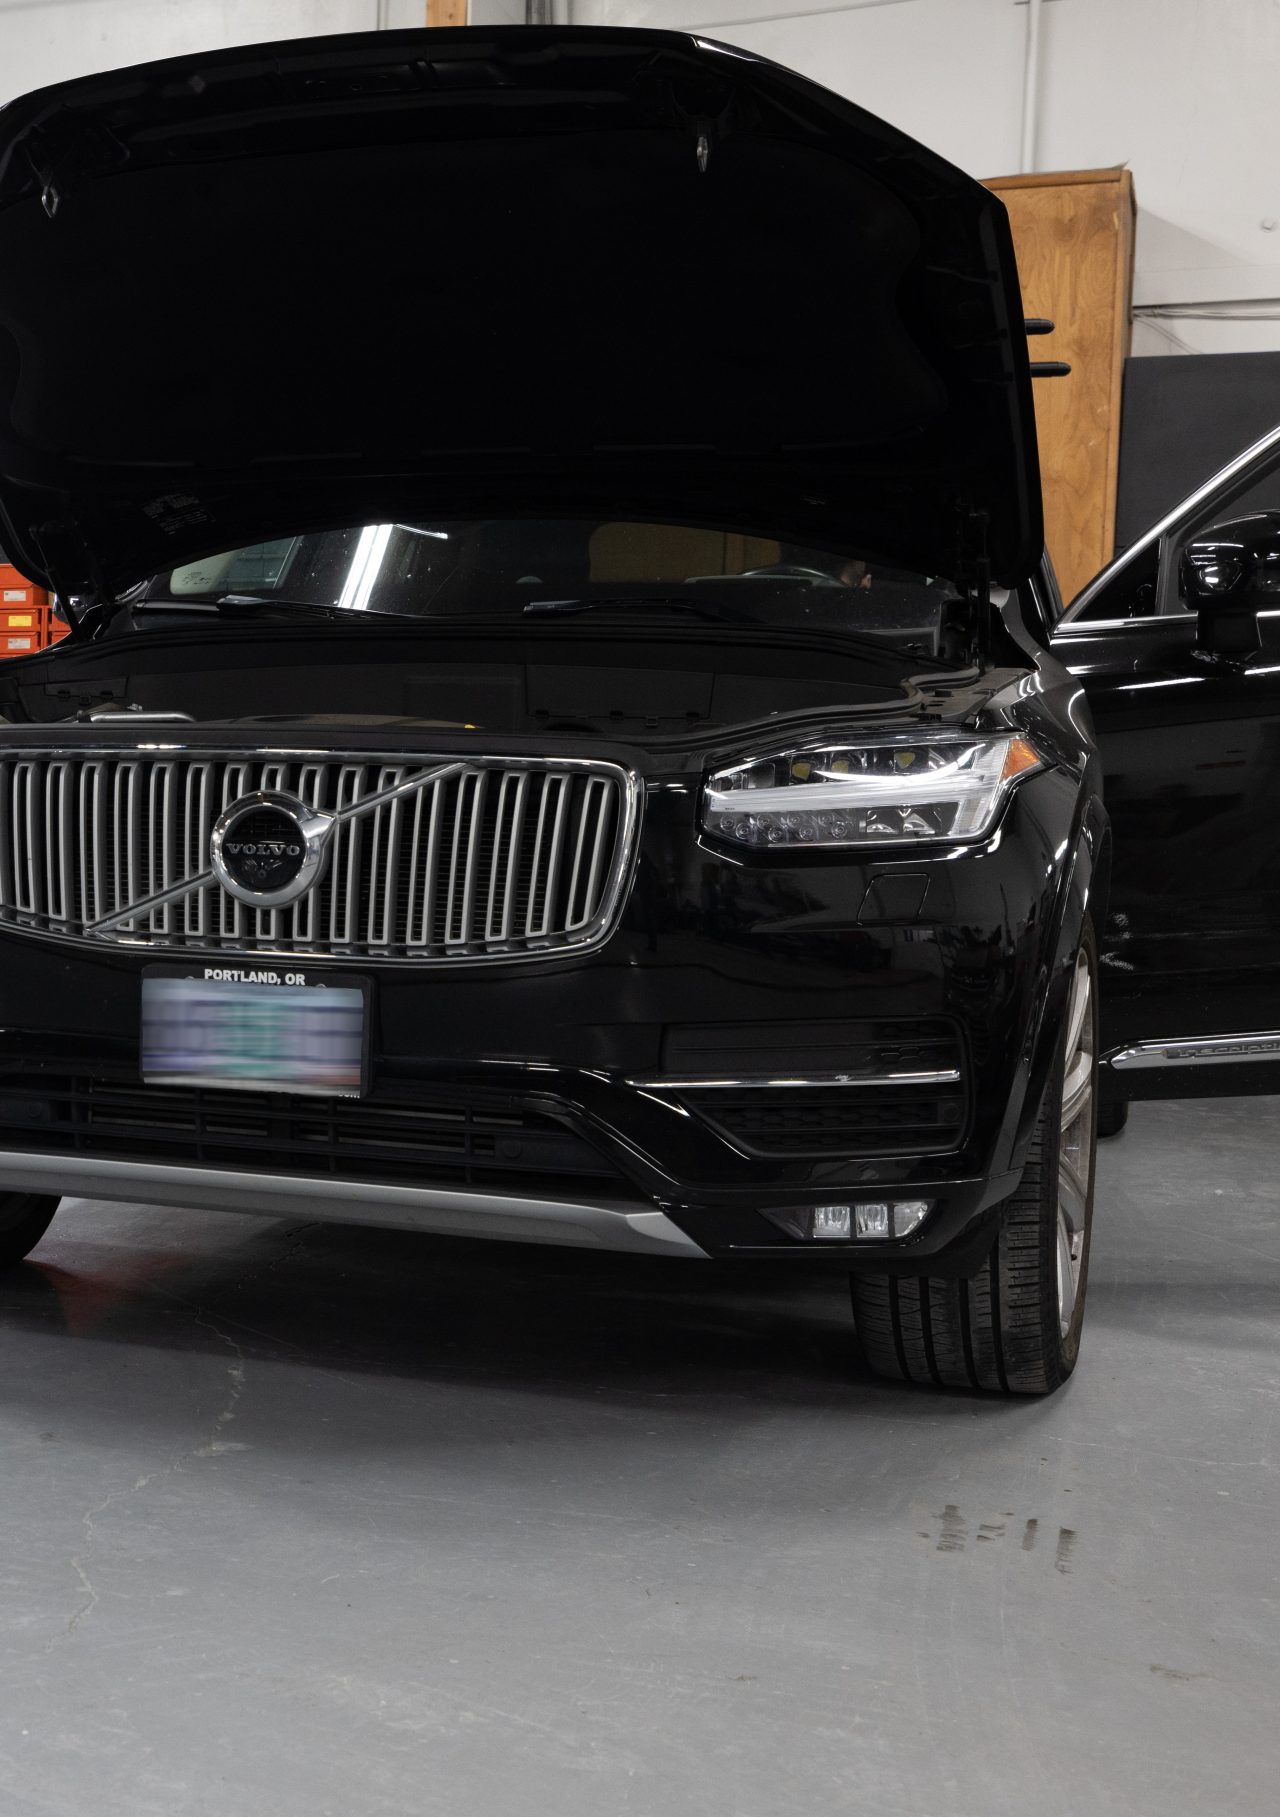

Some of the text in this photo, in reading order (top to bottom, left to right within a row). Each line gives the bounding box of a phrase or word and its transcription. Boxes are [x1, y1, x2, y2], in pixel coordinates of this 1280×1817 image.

[225, 843, 301, 856] VOLVO
[203, 968, 306, 987] PORTLAND, OR
